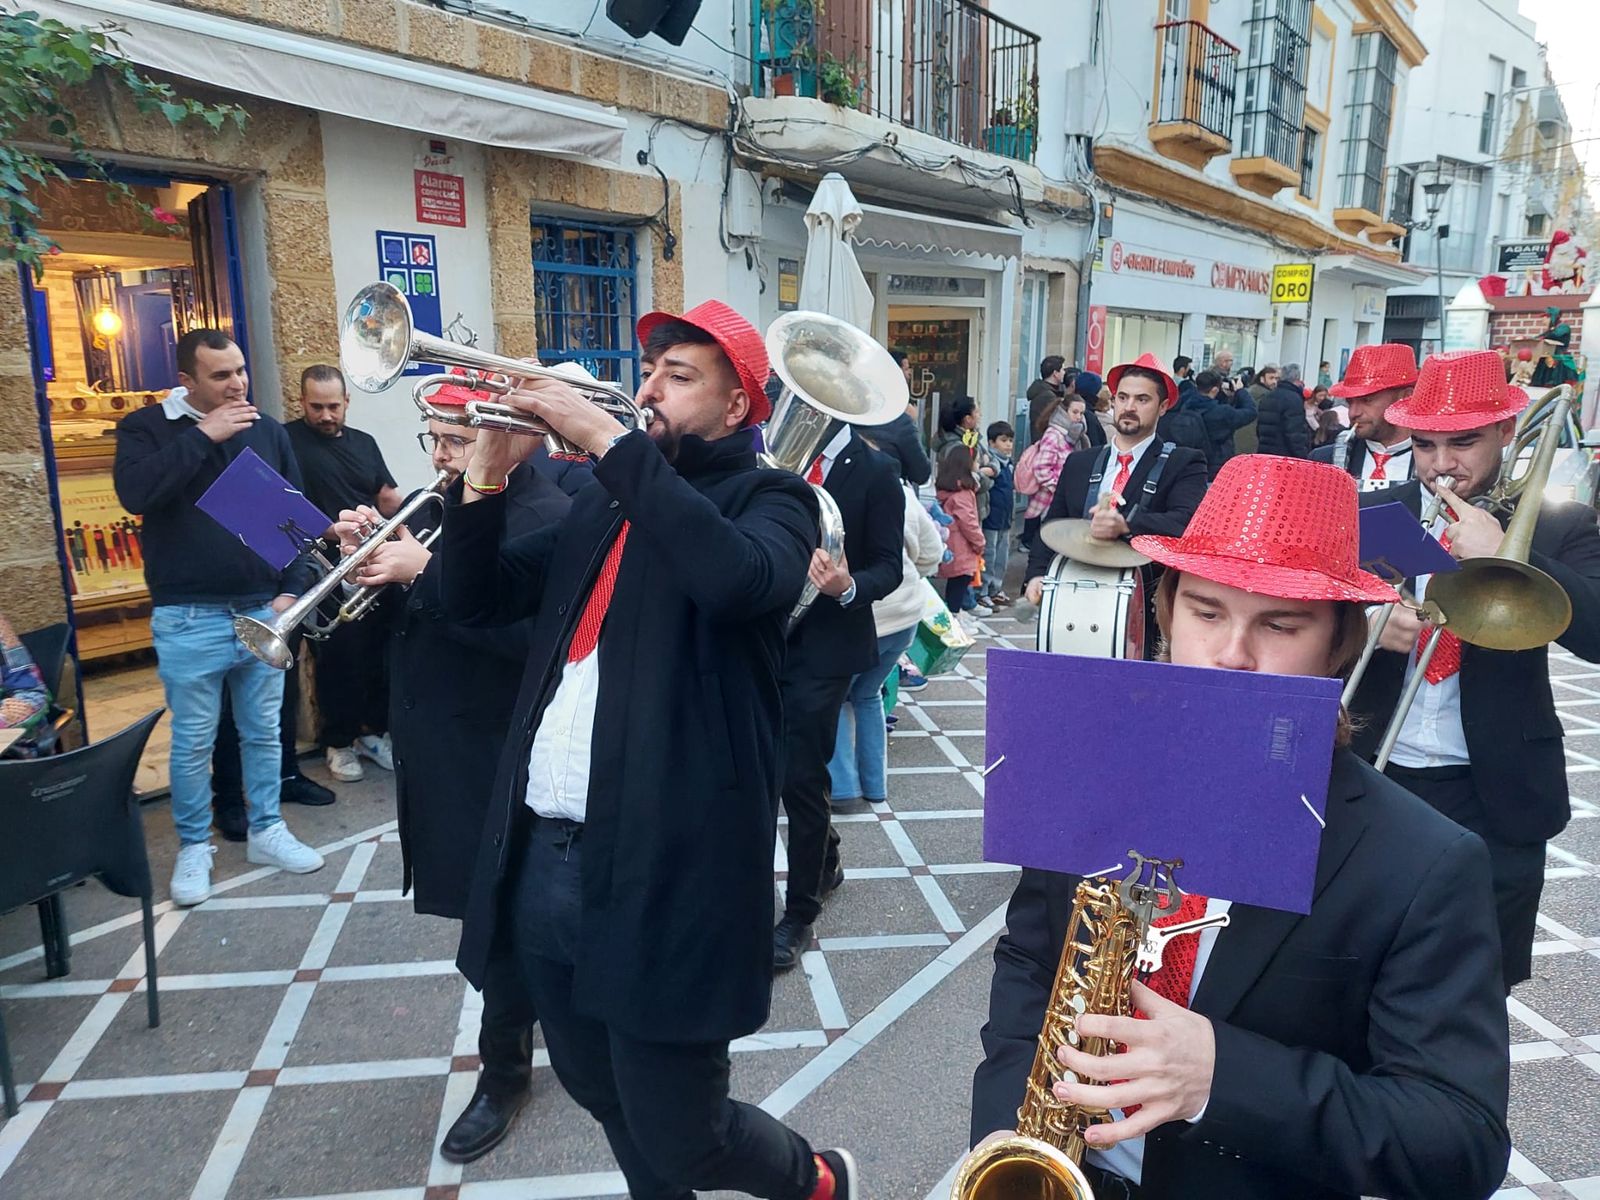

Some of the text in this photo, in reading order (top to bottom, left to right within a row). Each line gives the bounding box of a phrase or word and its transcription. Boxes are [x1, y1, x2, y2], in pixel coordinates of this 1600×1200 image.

[421, 174, 460, 191] Alarma
[1210, 262, 1270, 296] COMPRAMOS
[1276, 269, 1310, 278] COMPRO
[1275, 282, 1308, 298] ORO
